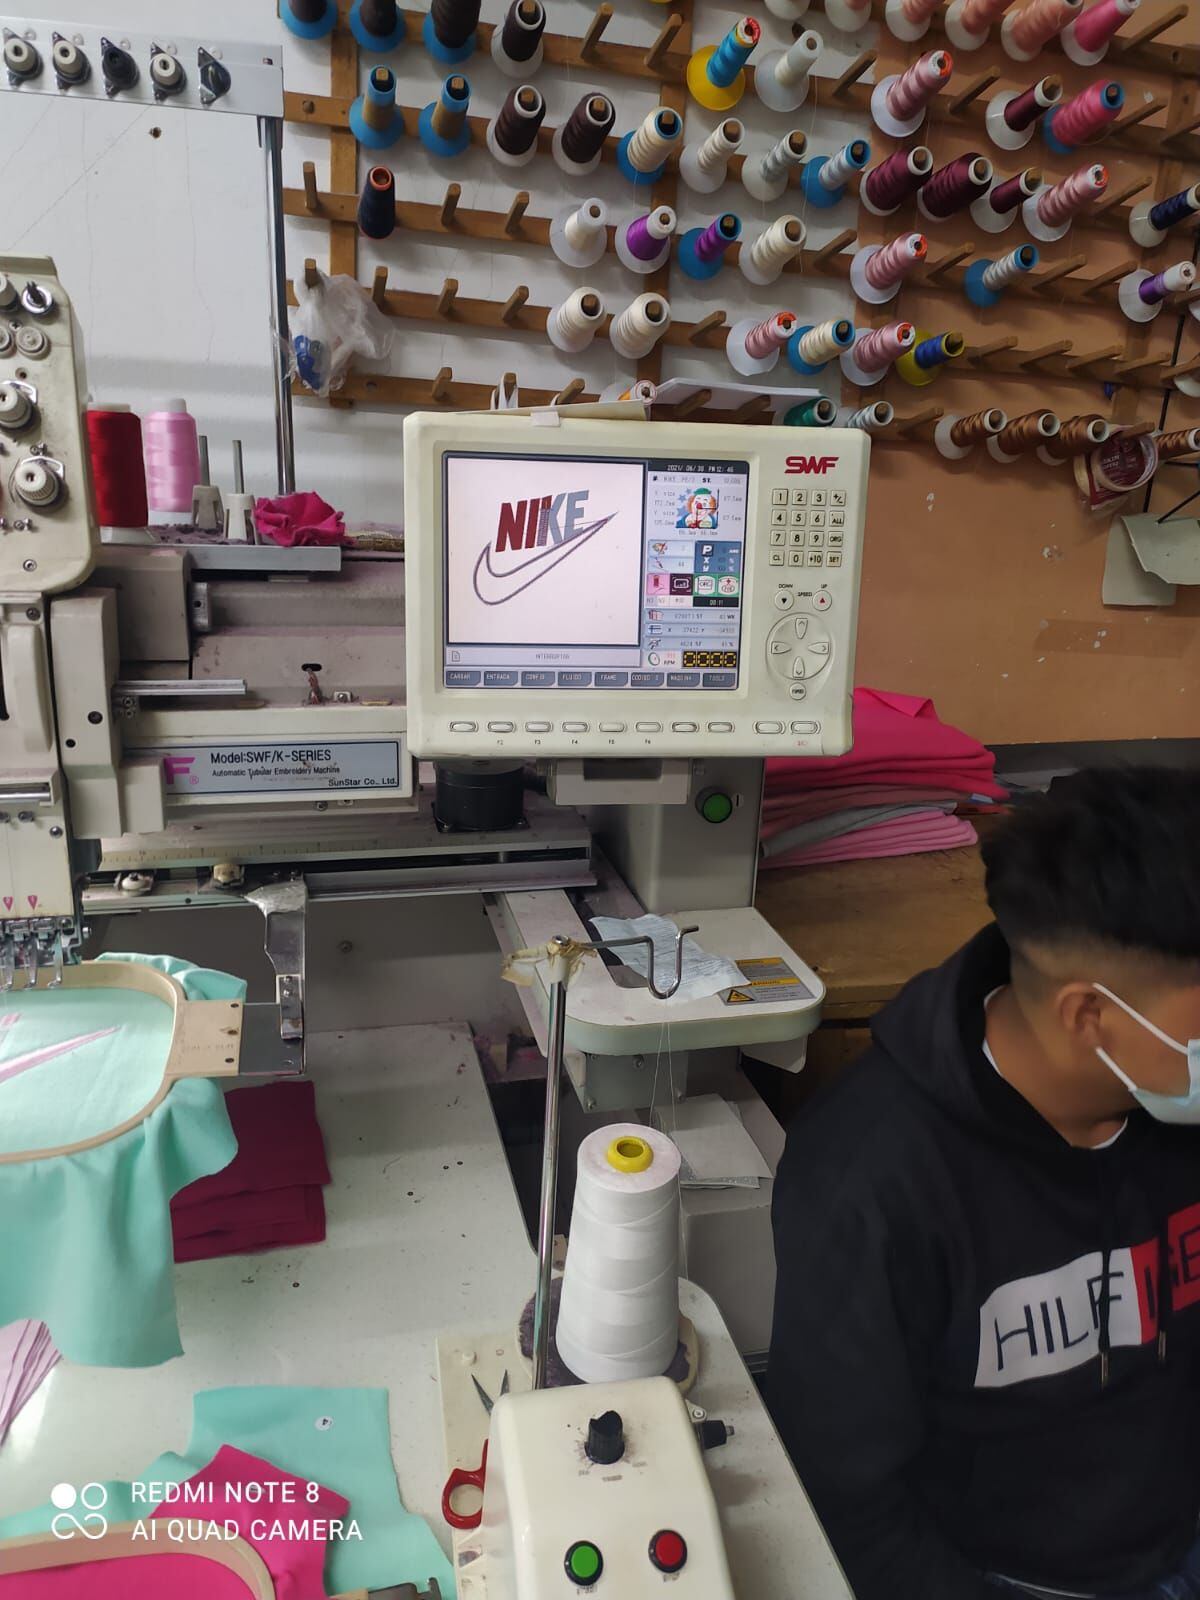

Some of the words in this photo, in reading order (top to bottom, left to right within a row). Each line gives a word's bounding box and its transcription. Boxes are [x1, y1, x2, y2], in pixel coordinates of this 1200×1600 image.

[784, 456, 839, 474] SWF
[797, 493, 803, 502] 2
[816, 494, 822, 502] 3
[495, 490, 589, 552] NIKE
[777, 514, 782, 522] 4
[796, 514, 801, 522] 5
[815, 514, 820, 523] 6
[775, 534, 781, 542] 7
[794, 534, 800, 543] 8
[813, 534, 819, 543] 9
[702, 545, 713, 555] P
[793, 555, 799, 563] 0
[212, 768, 246, 777] Automatic
[274, 766, 312, 776] Embroidery
[313, 765, 340, 774] Machine
[328, 778, 361, 787] SunStar
